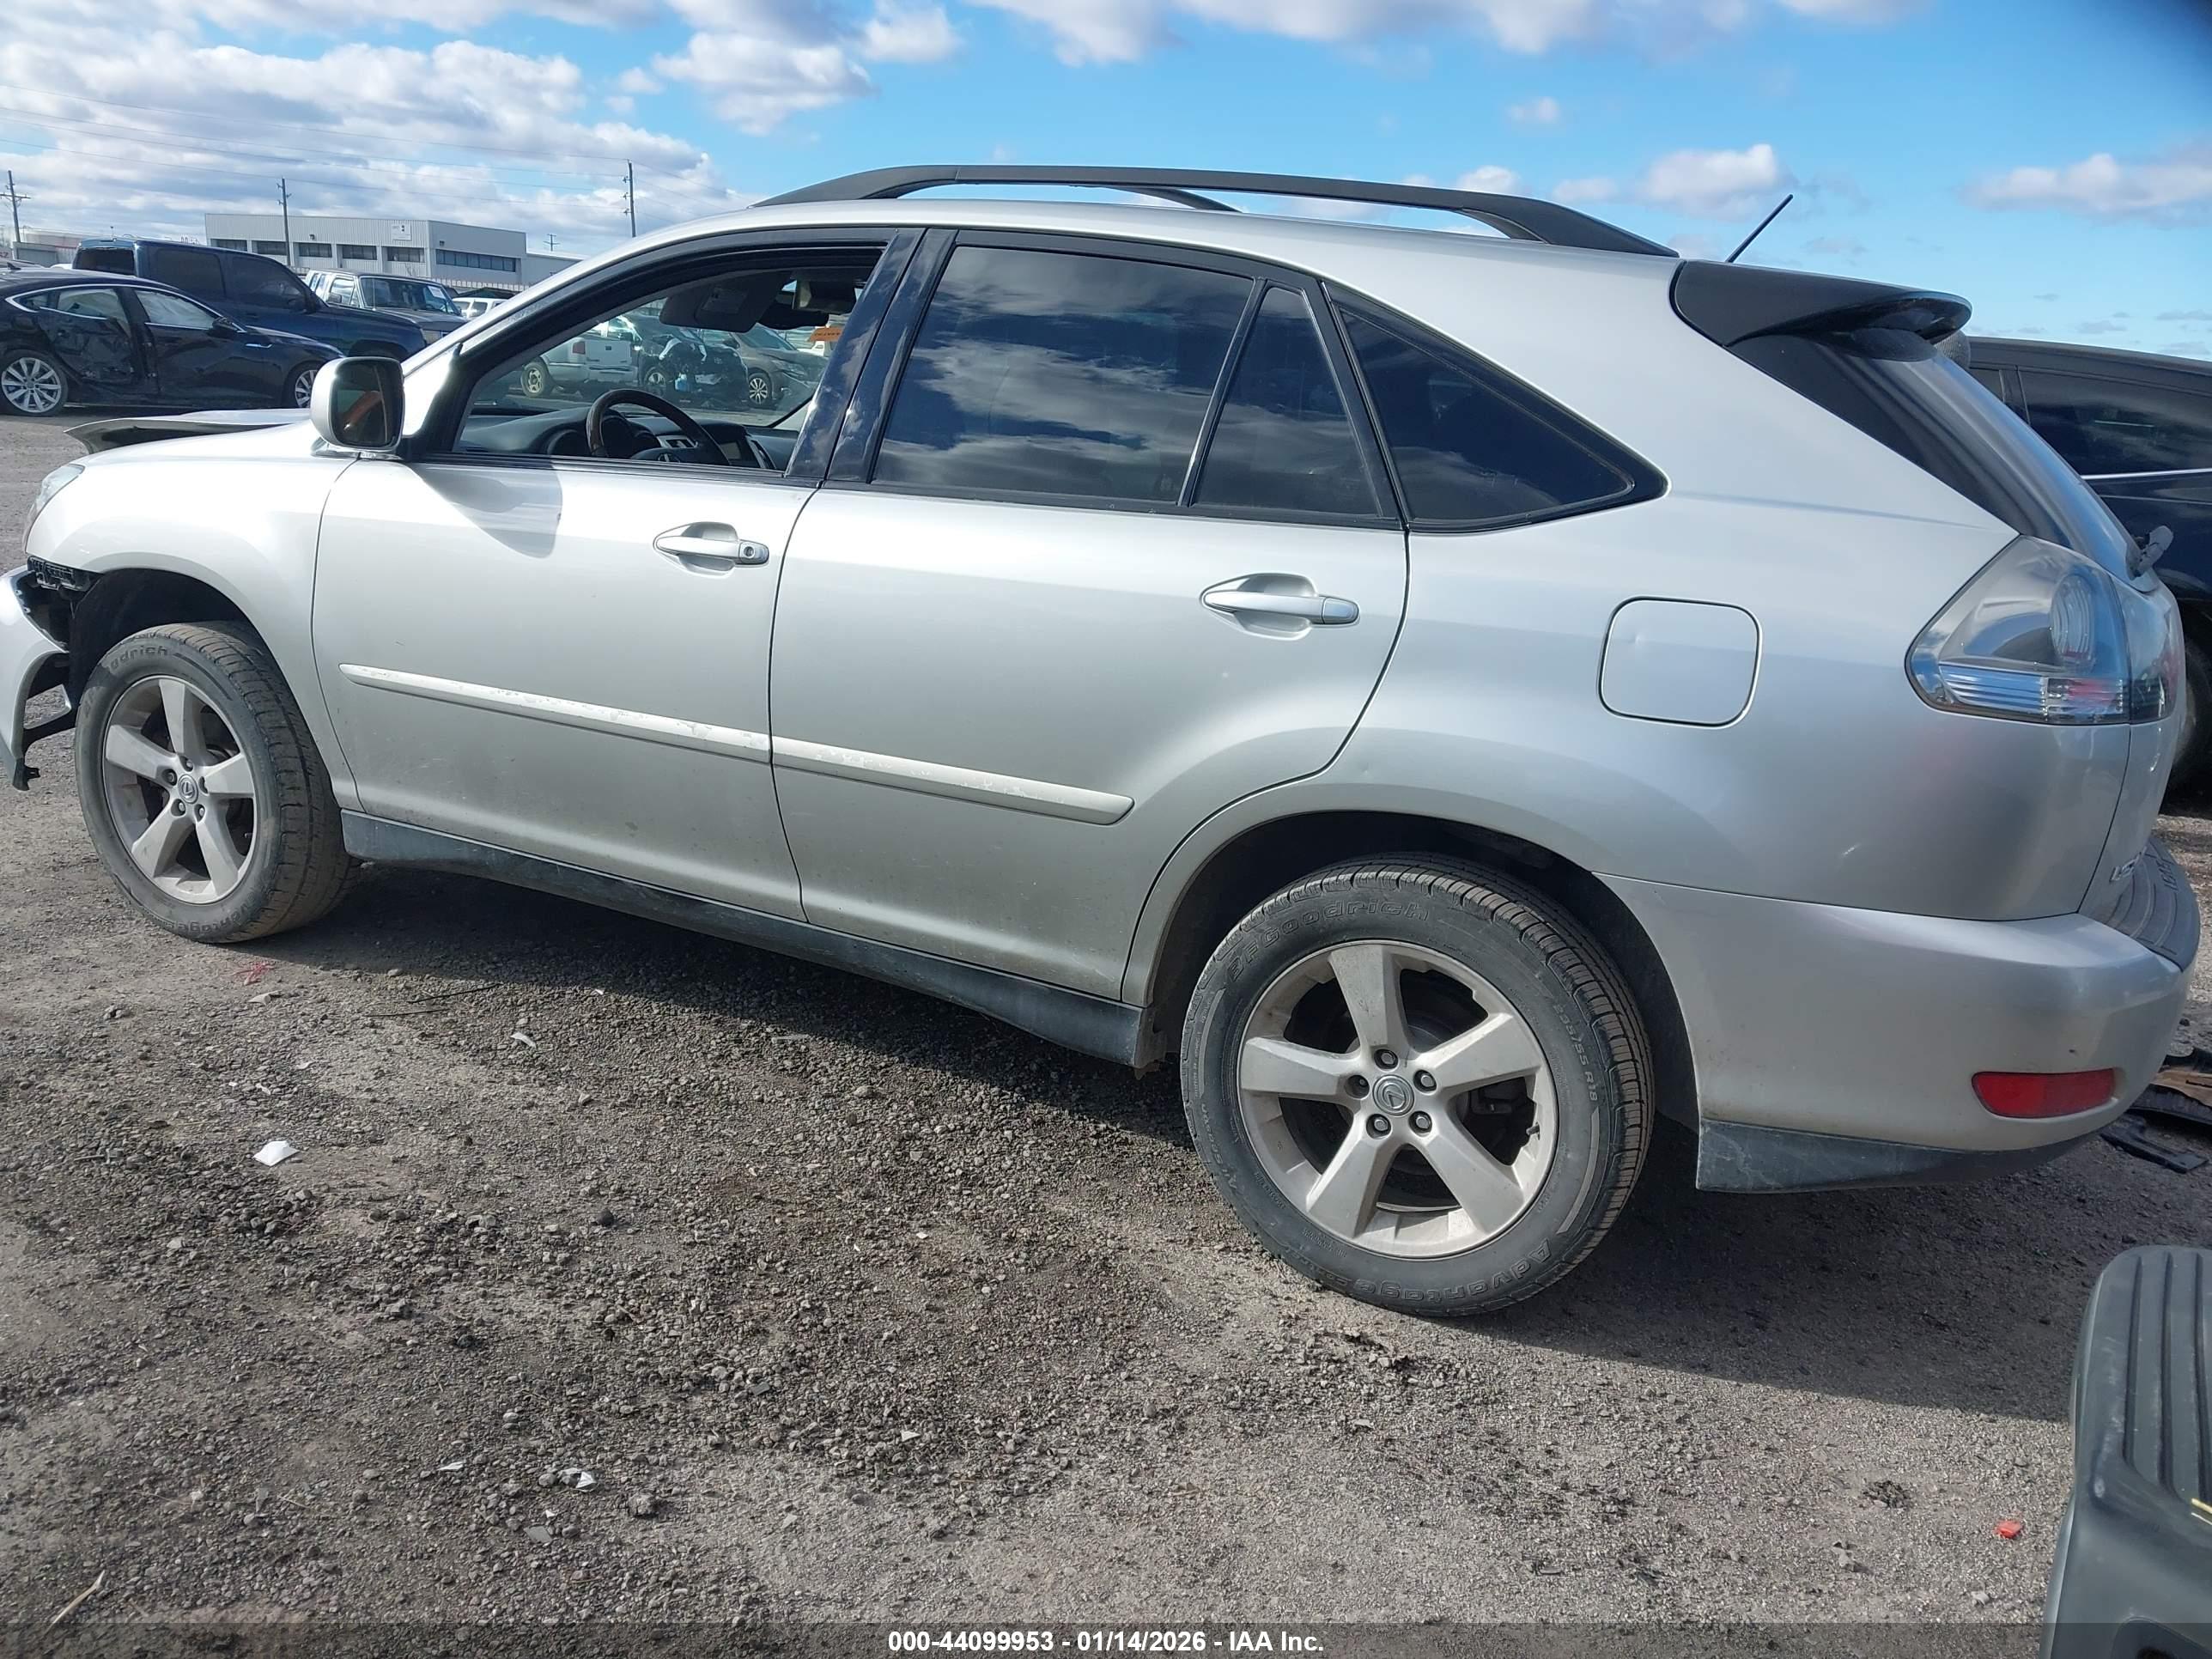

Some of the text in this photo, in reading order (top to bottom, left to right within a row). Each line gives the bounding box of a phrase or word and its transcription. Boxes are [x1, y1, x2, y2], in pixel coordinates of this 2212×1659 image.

[1227, 898, 1430, 983] BFGoodrich
[1583, 1070, 1599, 1102] R18
[1352, 1238, 1553, 1304] Advantage
